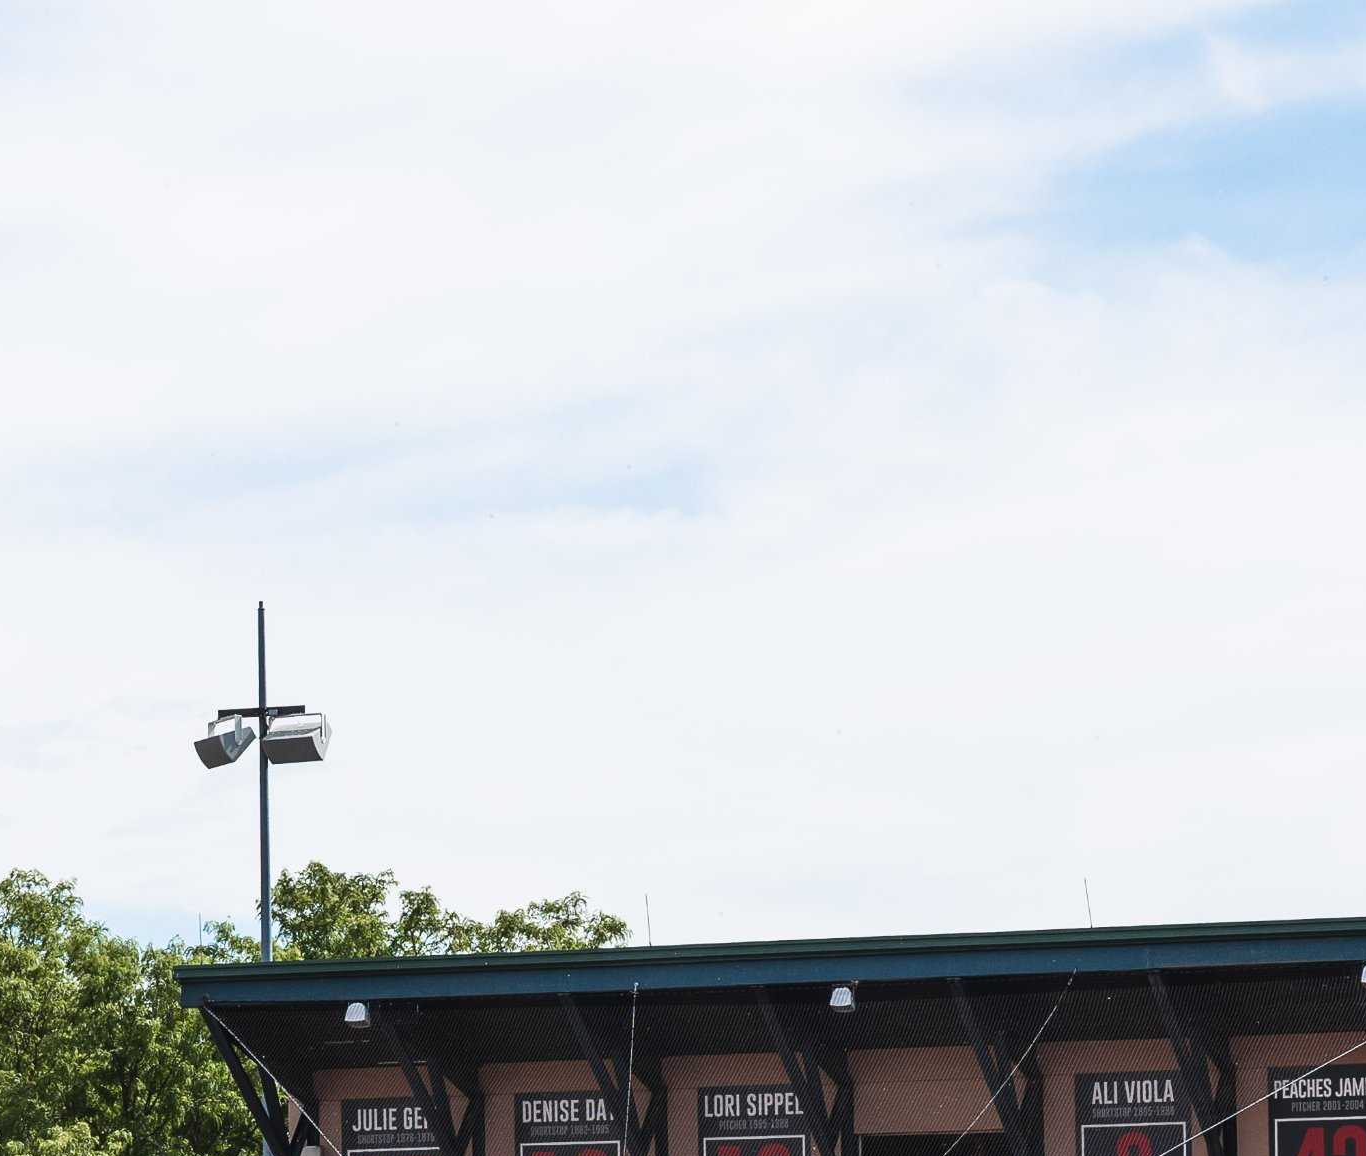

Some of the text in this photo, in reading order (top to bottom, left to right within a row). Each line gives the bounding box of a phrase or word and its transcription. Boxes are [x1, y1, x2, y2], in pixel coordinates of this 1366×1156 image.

[1091, 1079, 1175, 1105] ALI VIOLA
[1274, 1078, 1333, 1100] PEACHES
[522, 1098, 614, 1123] DENISE DA
[704, 1092, 804, 1118] LORI SIPPEL
[1291, 1099, 1364, 1113] PITCHER 2001-2004
[352, 1108, 398, 1132] JULIE
